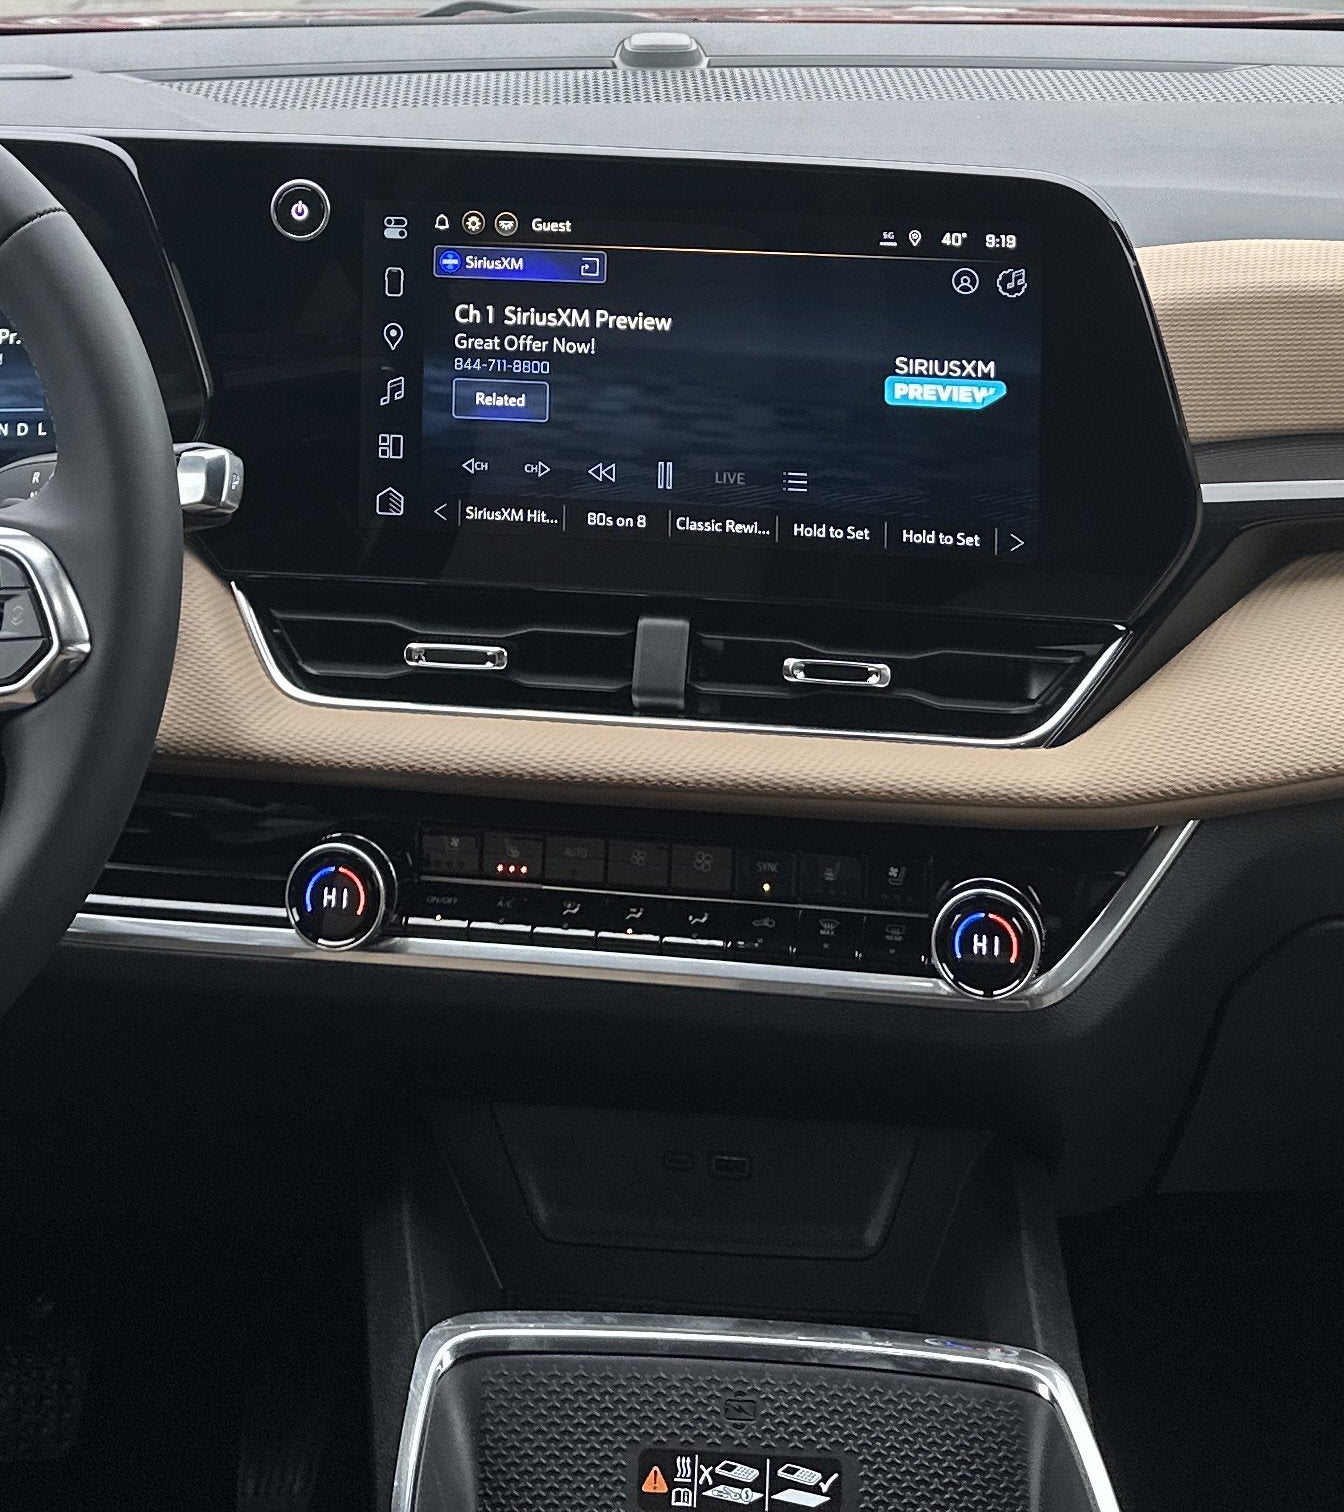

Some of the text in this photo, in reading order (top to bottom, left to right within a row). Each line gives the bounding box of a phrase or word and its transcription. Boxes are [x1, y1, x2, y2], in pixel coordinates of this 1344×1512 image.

[532, 218, 571, 233] Guest
[941, 232, 968, 247] 40°
[985, 234, 1016, 248] 9:19
[465, 256, 524, 271] SiriusXM
[454, 303, 673, 332] Ch 1 SiriusXM Preview
[454, 333, 596, 354] Great Offer Now!
[454, 357, 550, 374] 844-711-8800
[894, 356, 996, 379] SIRIUSXM
[475, 392, 526, 408] Related
[893, 382, 996, 403] PREVIEW
[17, 422, 28, 436] D
[38, 422, 47, 436] L
[474, 461, 488, 471] CH
[524, 463, 537, 473] CH
[30, 472, 41, 484] R
[714, 472, 746, 485] LIVE
[465, 506, 524, 523] SiriusXM
[587, 512, 647, 528] 80s on 8
[675, 516, 723, 534] Classic
[793, 523, 870, 540] Hold to Set
[902, 529, 980, 547] Hold to Set
[756, 862, 779, 873] SYNC
[323, 888, 348, 908] HI
[973, 934, 999, 956] HI
